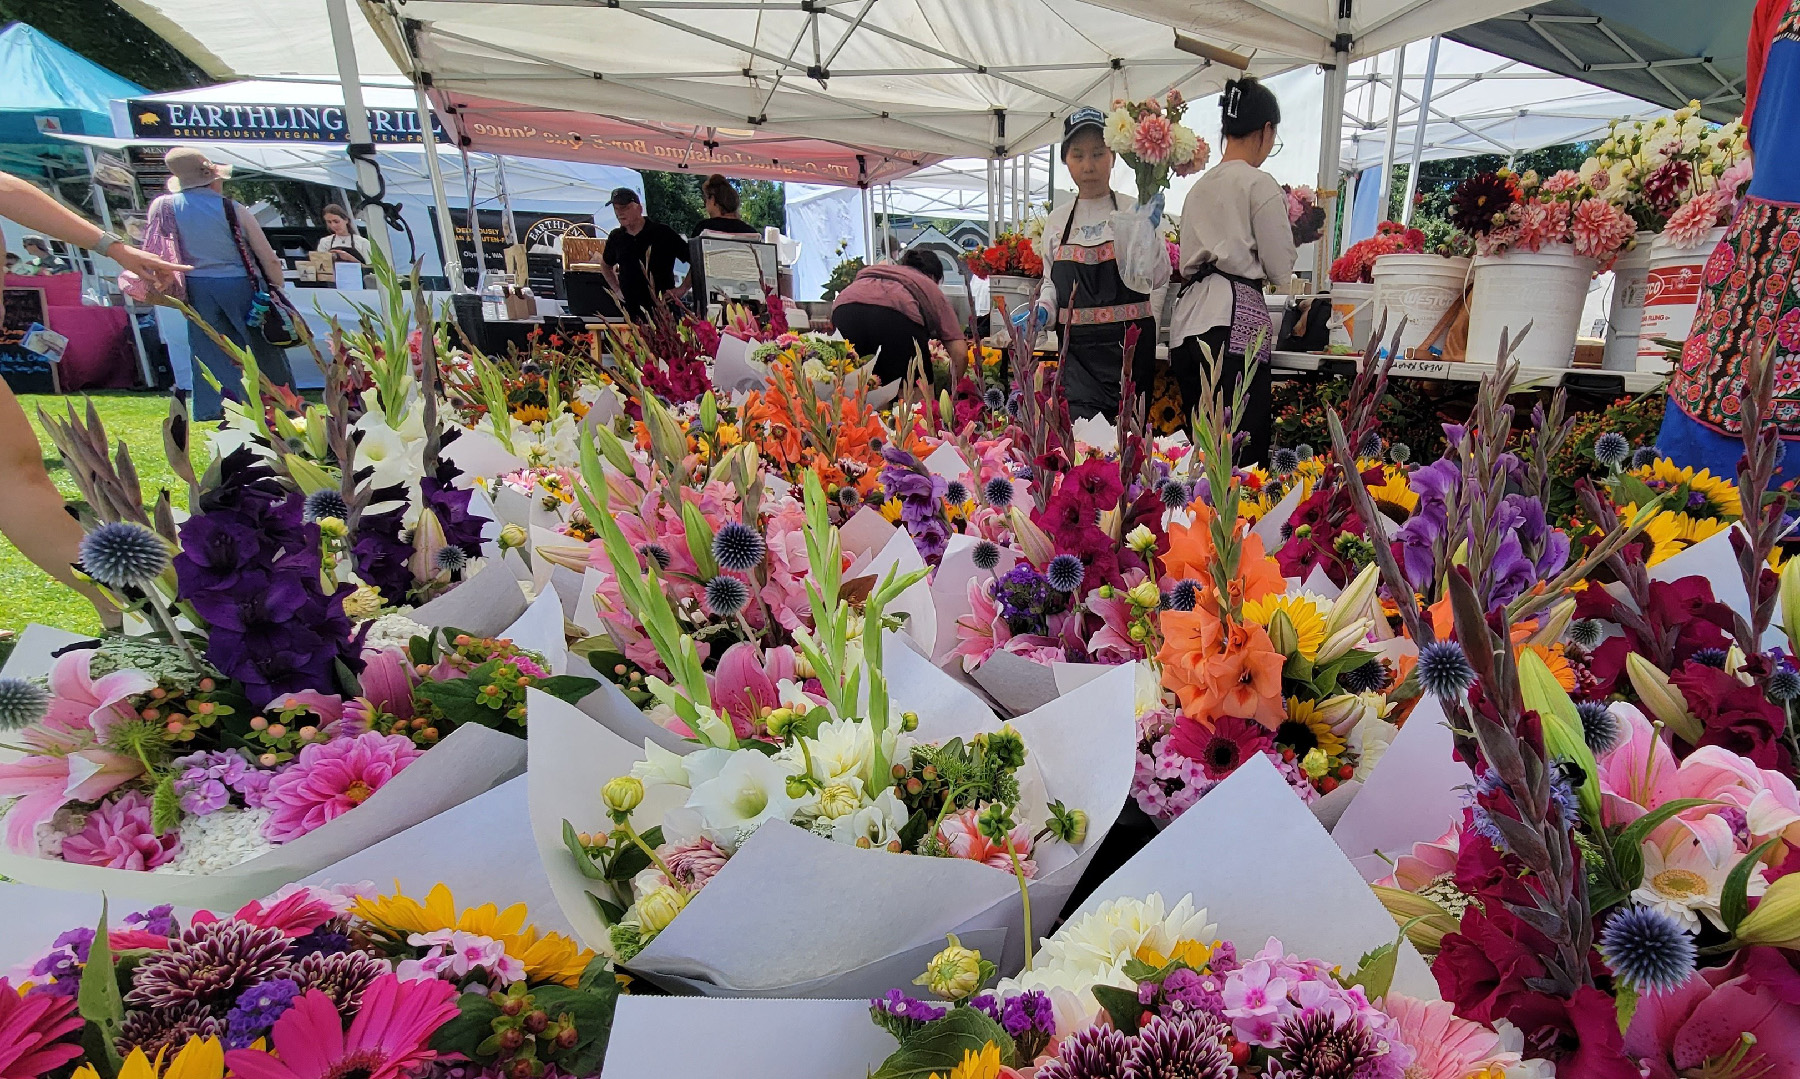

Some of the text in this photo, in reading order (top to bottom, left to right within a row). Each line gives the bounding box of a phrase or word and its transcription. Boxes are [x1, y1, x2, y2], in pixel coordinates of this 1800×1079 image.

[167, 104, 343, 131] EARTHLING
[174, 128, 266, 138] DELICIOUSLY
[274, 131, 320, 140] VEGAN
[329, 132, 336, 140] &
[455, 227, 499, 235] DELIOUSLY
[528, 220, 581, 241] EARTHLN
